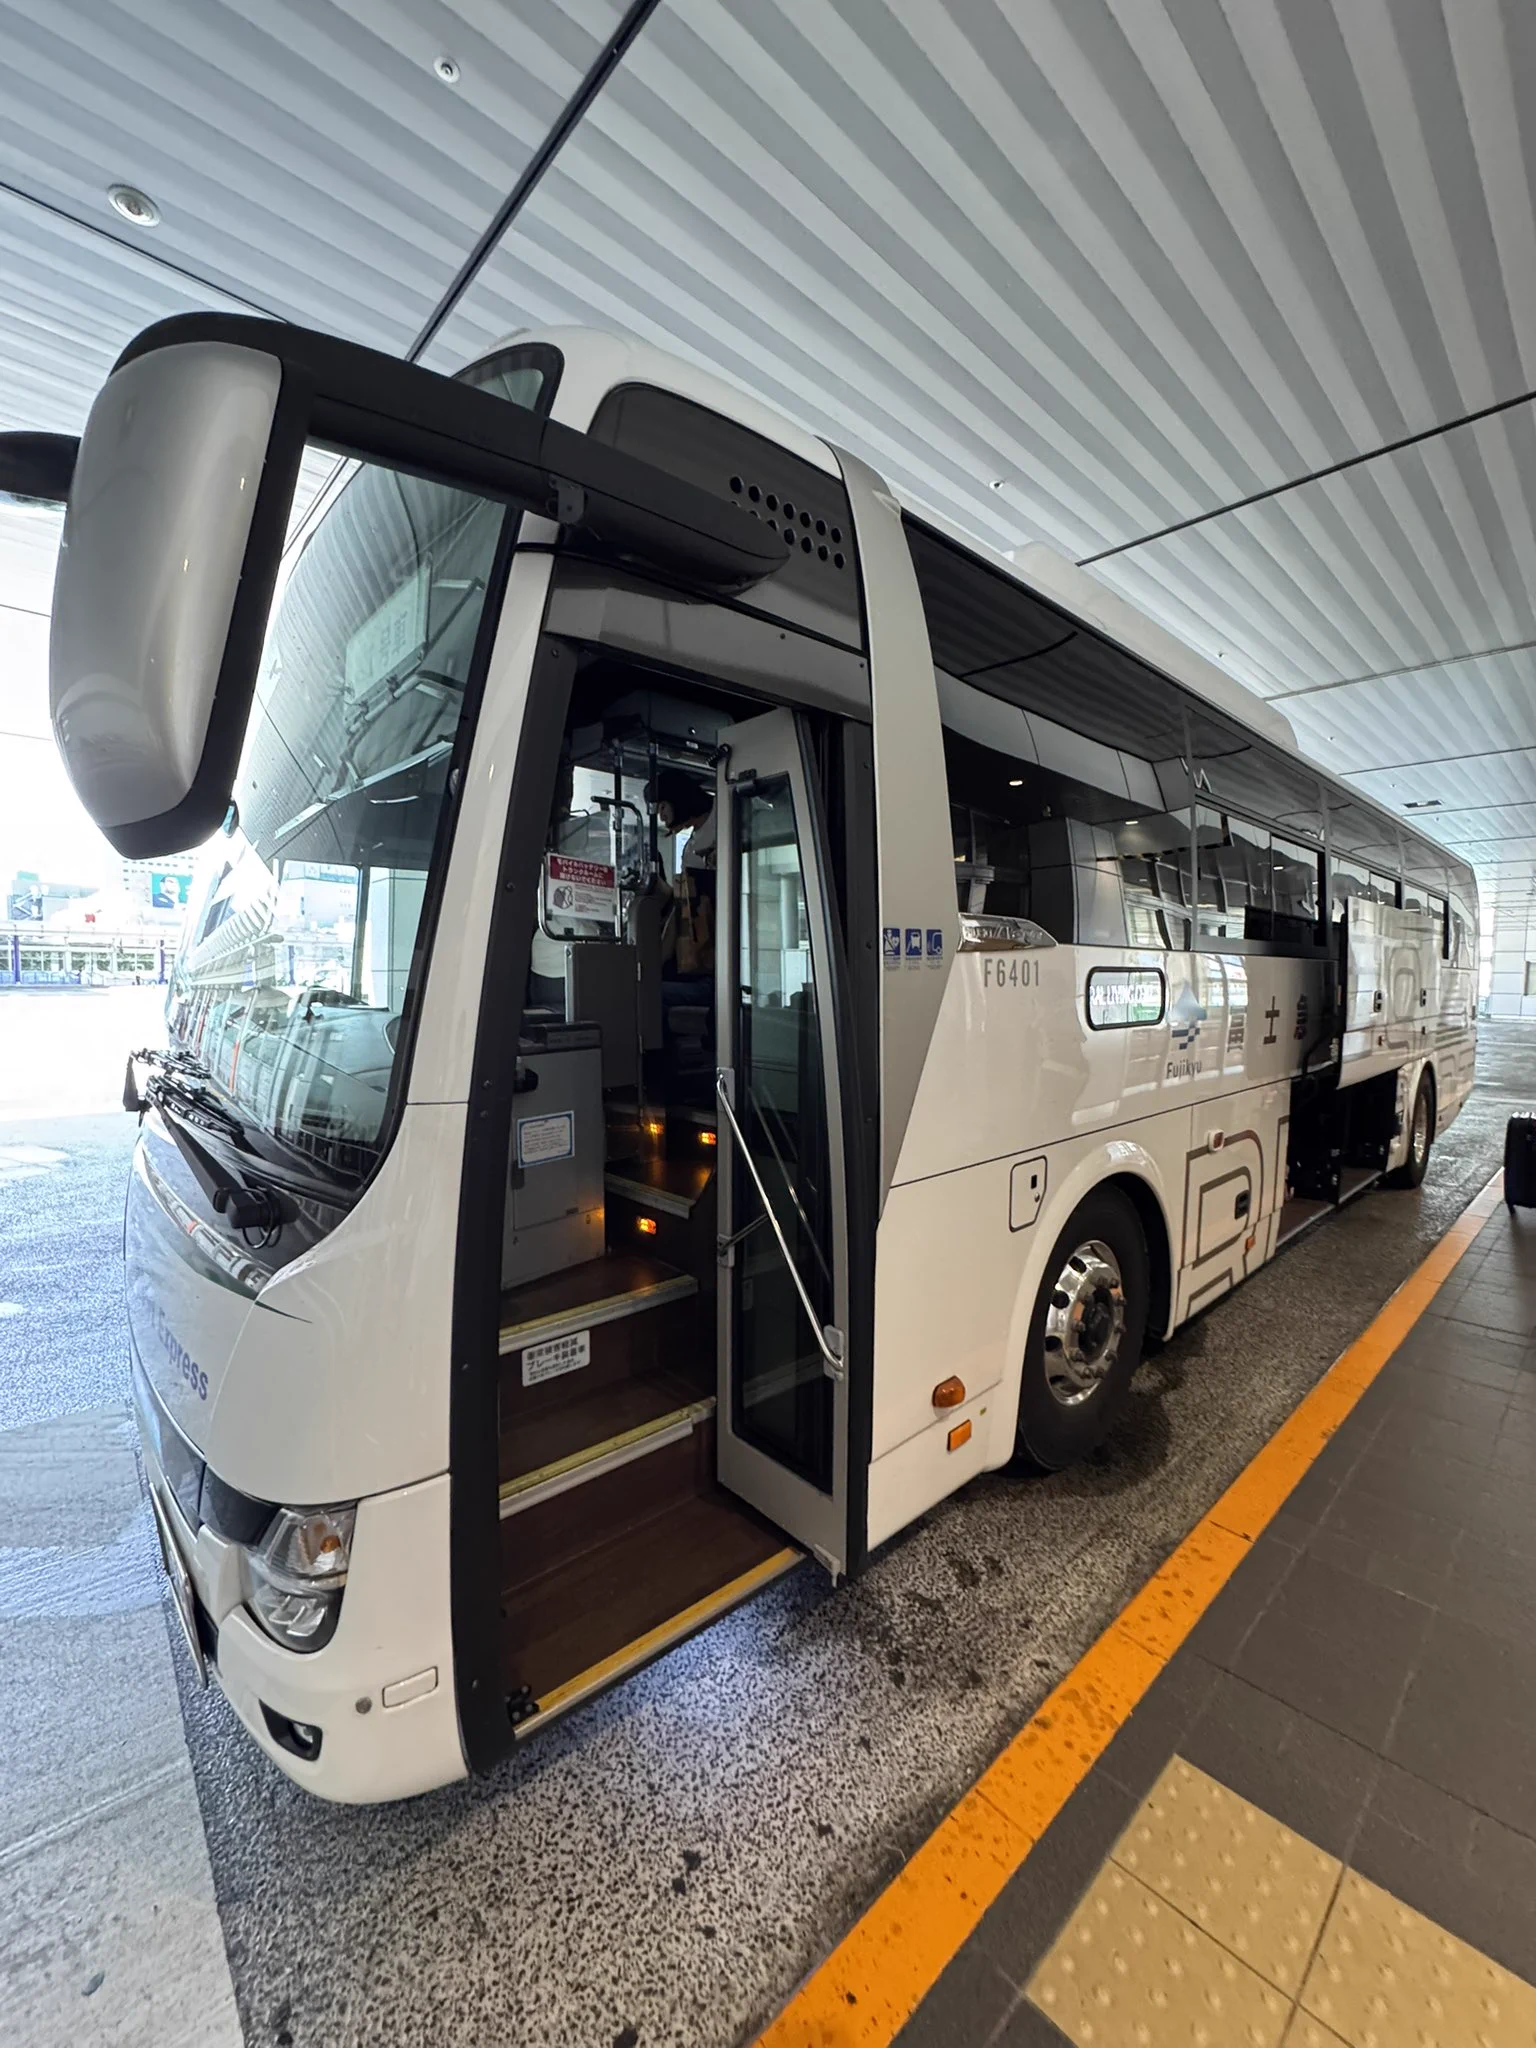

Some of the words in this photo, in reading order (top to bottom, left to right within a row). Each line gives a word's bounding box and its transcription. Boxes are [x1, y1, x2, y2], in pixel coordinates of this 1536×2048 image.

[556, 858, 609, 873] モバイルバッテリーは
[562, 866, 605, 879] トランクルームに
[984, 958, 1039, 988] F6401
[1166, 1059, 1202, 1080] Fujikyu
